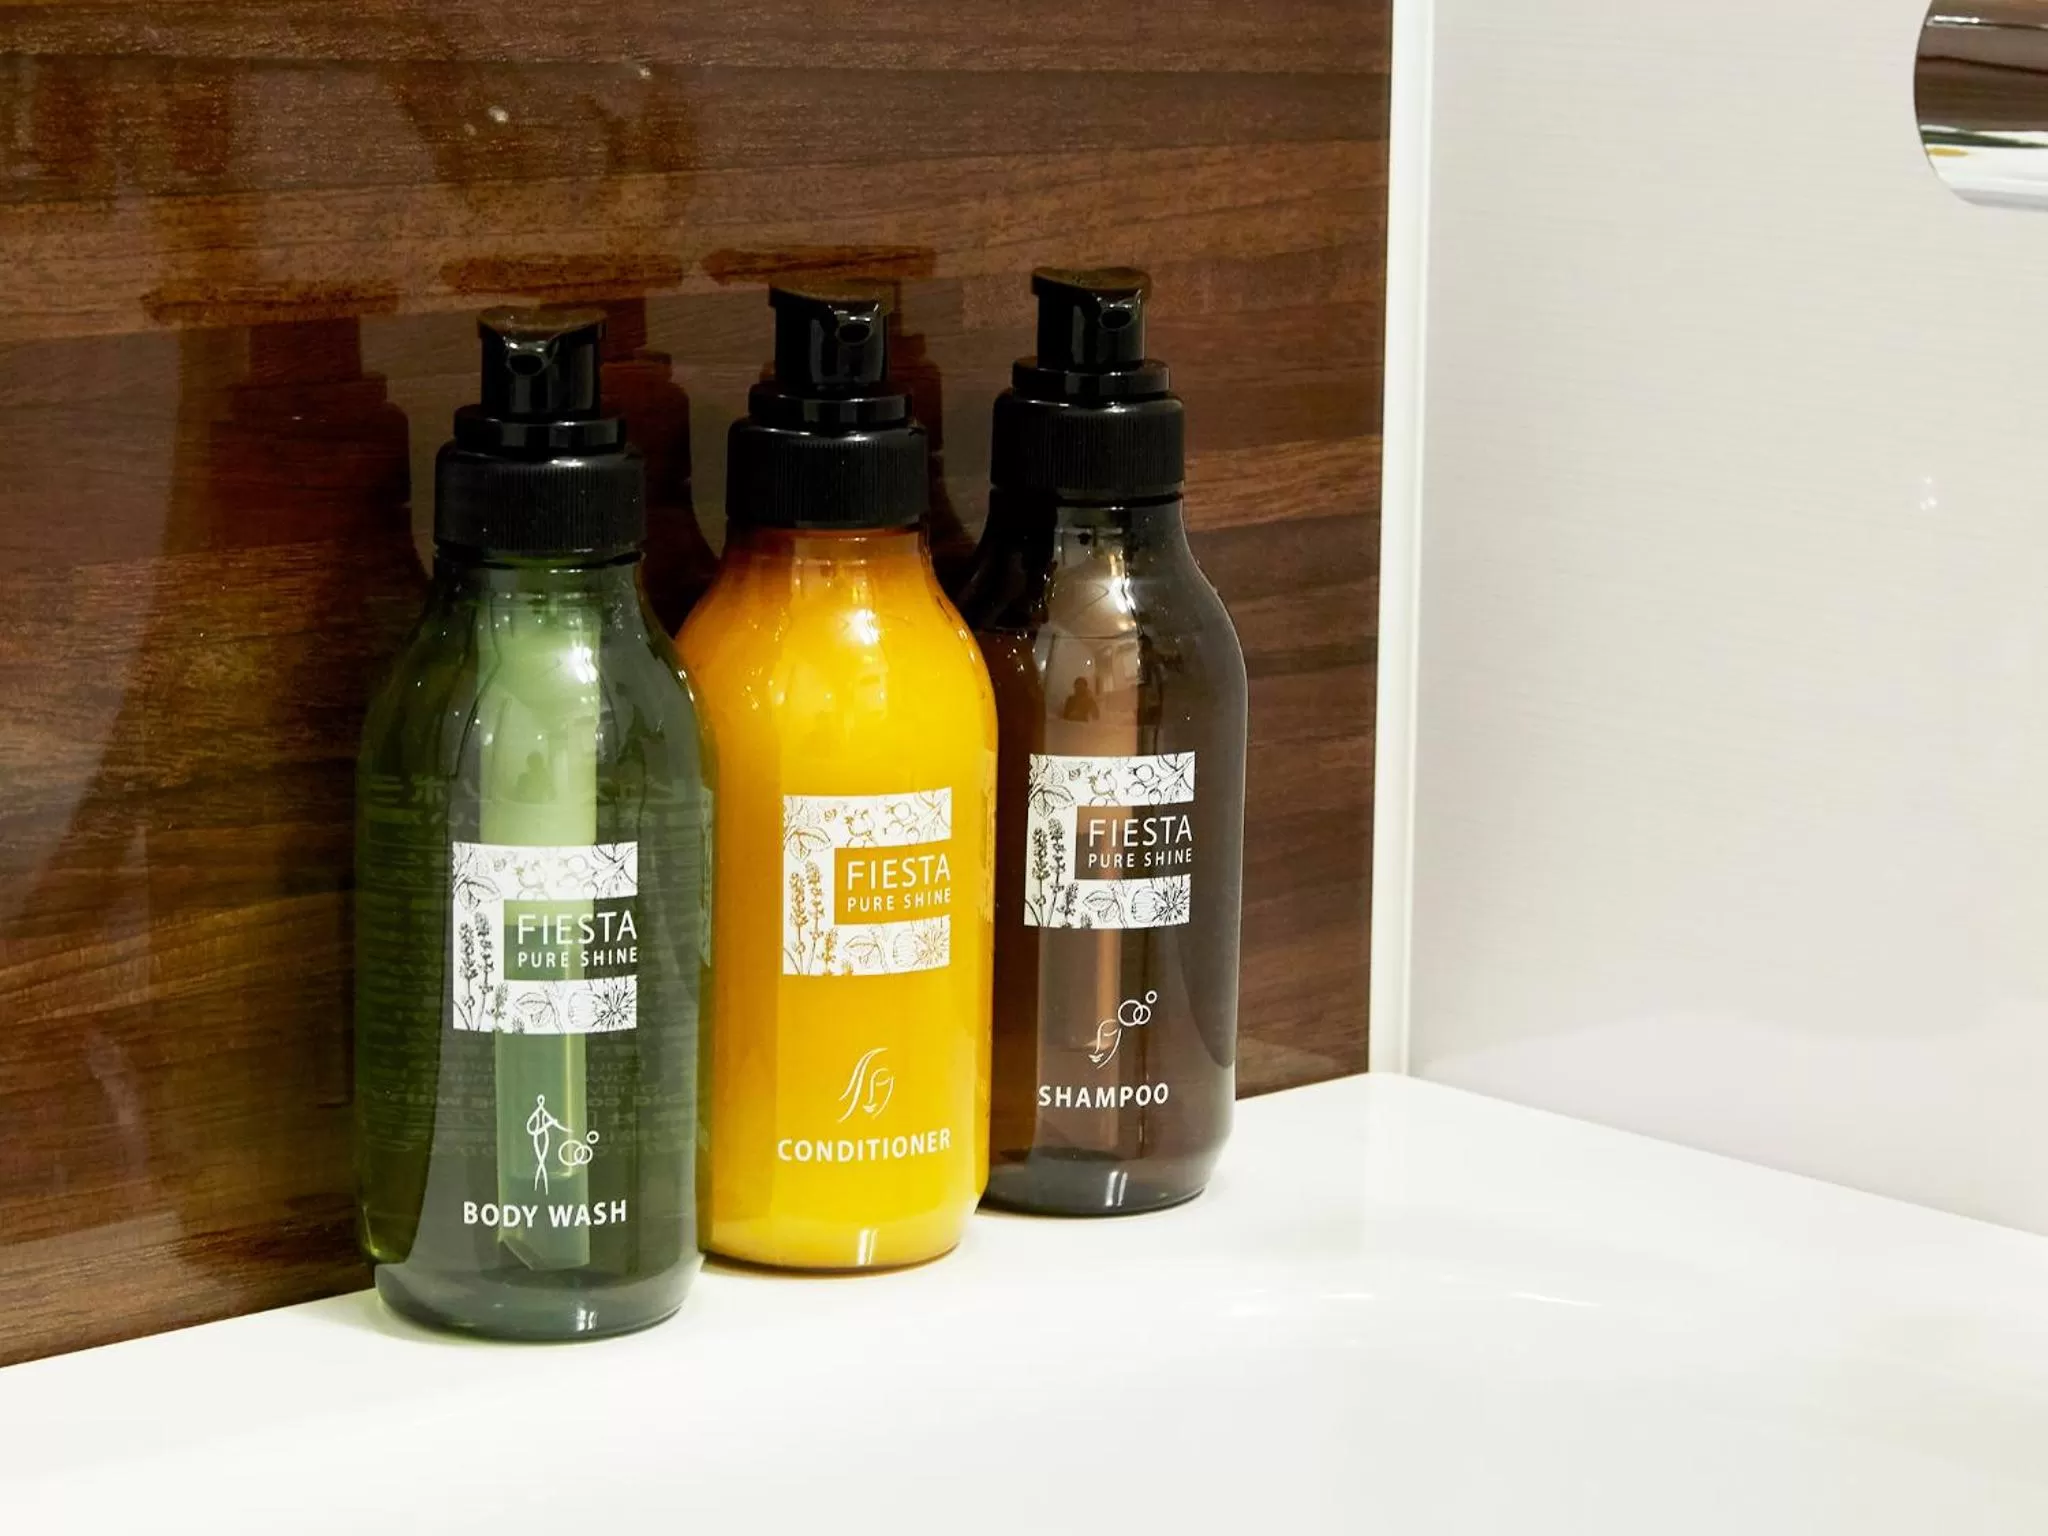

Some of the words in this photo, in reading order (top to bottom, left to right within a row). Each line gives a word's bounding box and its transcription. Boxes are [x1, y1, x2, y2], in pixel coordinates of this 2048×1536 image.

[1088, 814, 1193, 847] FIESTA
[1088, 852, 1135, 869] PURE
[1143, 847, 1192, 868] SHINE
[847, 853, 951, 891] FIESTA
[847, 895, 895, 913] PURE
[903, 887, 951, 909] SHINE
[517, 910, 638, 945] FIESTA
[518, 951, 569, 968] PURE
[580, 946, 638, 967] SHINE
[1038, 1082, 1169, 1108] SHAMPOO
[777, 1127, 951, 1163] CONDITIONER
[463, 1201, 538, 1227] BODY
[548, 1200, 627, 1227] WASH
